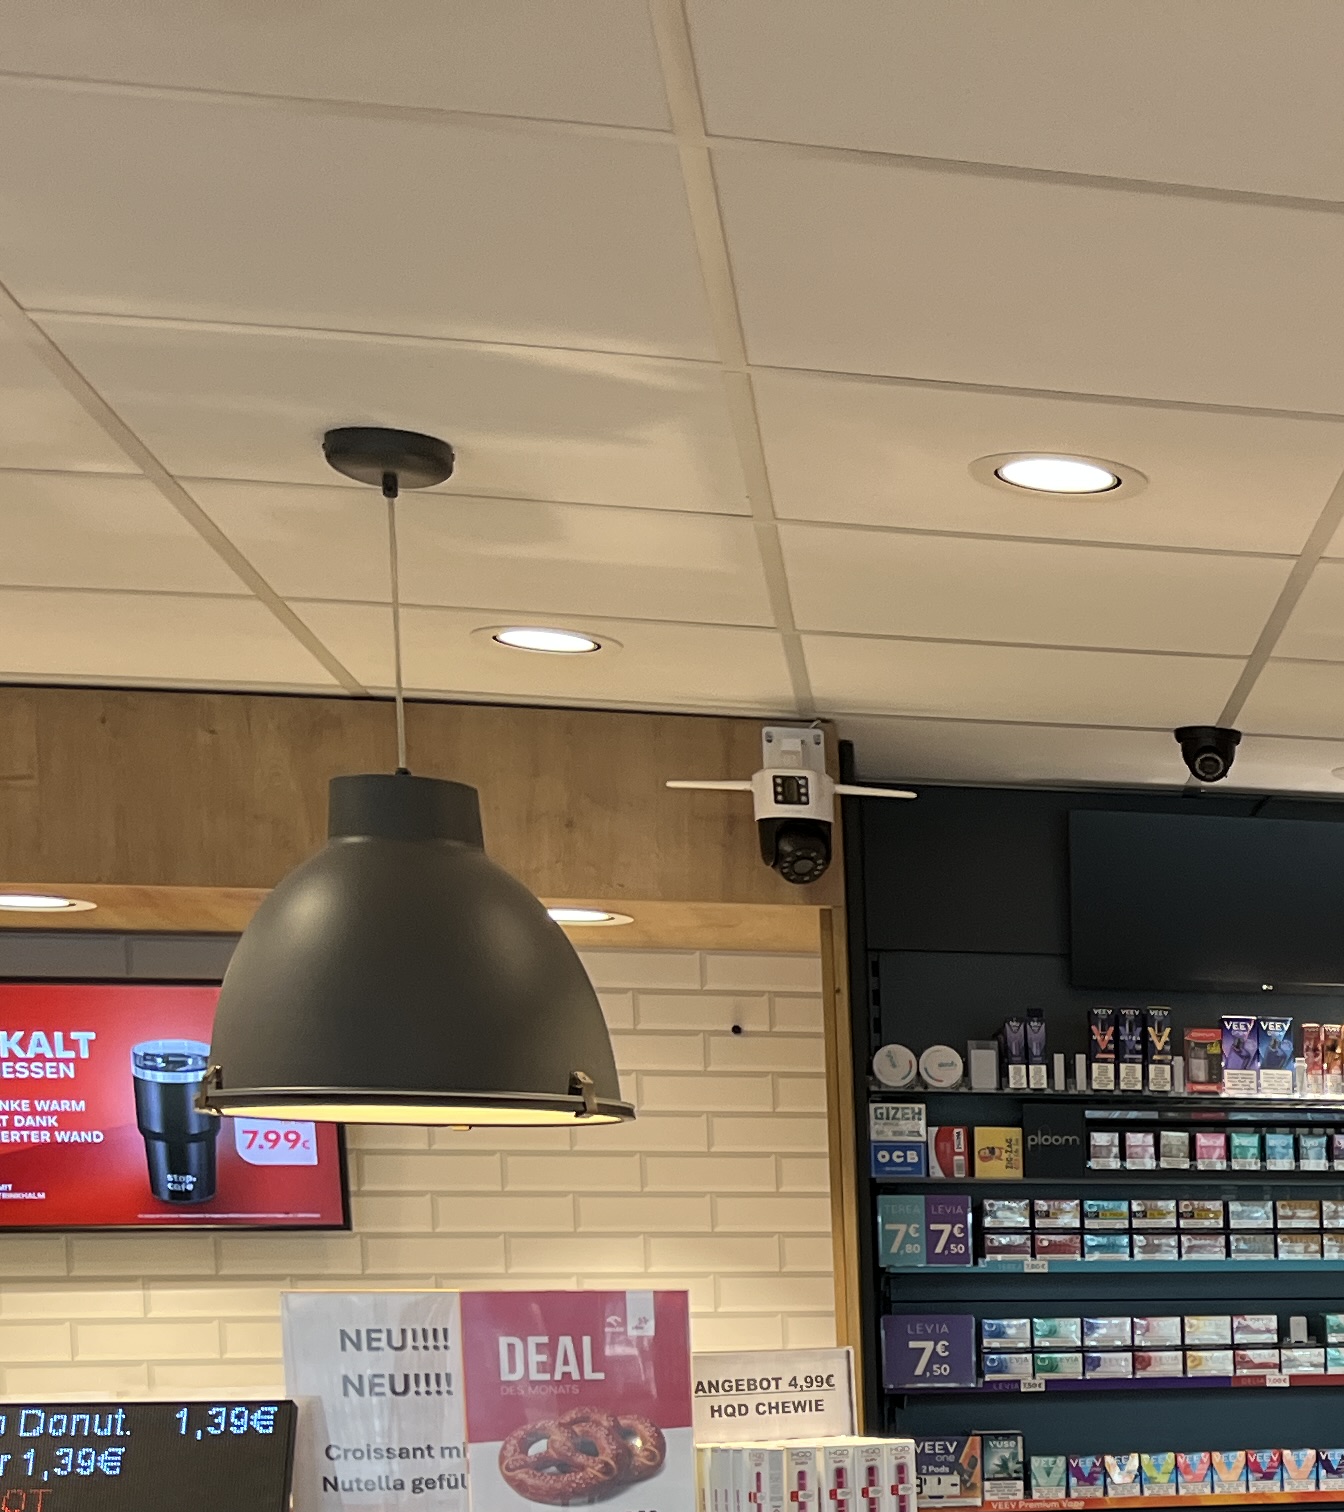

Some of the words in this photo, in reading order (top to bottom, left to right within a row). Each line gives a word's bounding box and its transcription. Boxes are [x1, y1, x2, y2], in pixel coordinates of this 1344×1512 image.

[0, 1031, 96, 1059] KALT
[34, 1100, 86, 1112] WARM
[874, 1107, 922, 1121] GIZEH
[14, 1115, 58, 1127] DANK
[55, 1131, 104, 1143] WAND
[1027, 1131, 1080, 1148] ploom
[877, 1150, 919, 1163] OCB
[931, 1204, 963, 1215] LEVIA
[907, 1324, 949, 1334] LEVIA
[339, 1328, 450, 1352] NEU!!!!
[498, 1335, 605, 1382] DEAL
[342, 1373, 454, 1397] NEU!!!!
[501, 1385, 527, 1396] DES
[530, 1383, 580, 1396] MONATS
[694, 1376, 783, 1395] ANGEBOT
[788, 1373, 836, 1393] 4,99€
[710, 1402, 750, 1419] HQD
[755, 1399, 825, 1416] CHEWIE
[176, 1407, 279, 1440] 1,39€
[325, 1444, 435, 1462] Croissant
[915, 1441, 957, 1453] VEEV
[23, 1448, 126, 1480] 1,39€
[323, 1475, 405, 1492] Nutella
[991, 1501, 1016, 1510] VEEV
[1019, 1500, 1059, 1509] Premium
[1062, 1500, 1085, 1510] Vape
